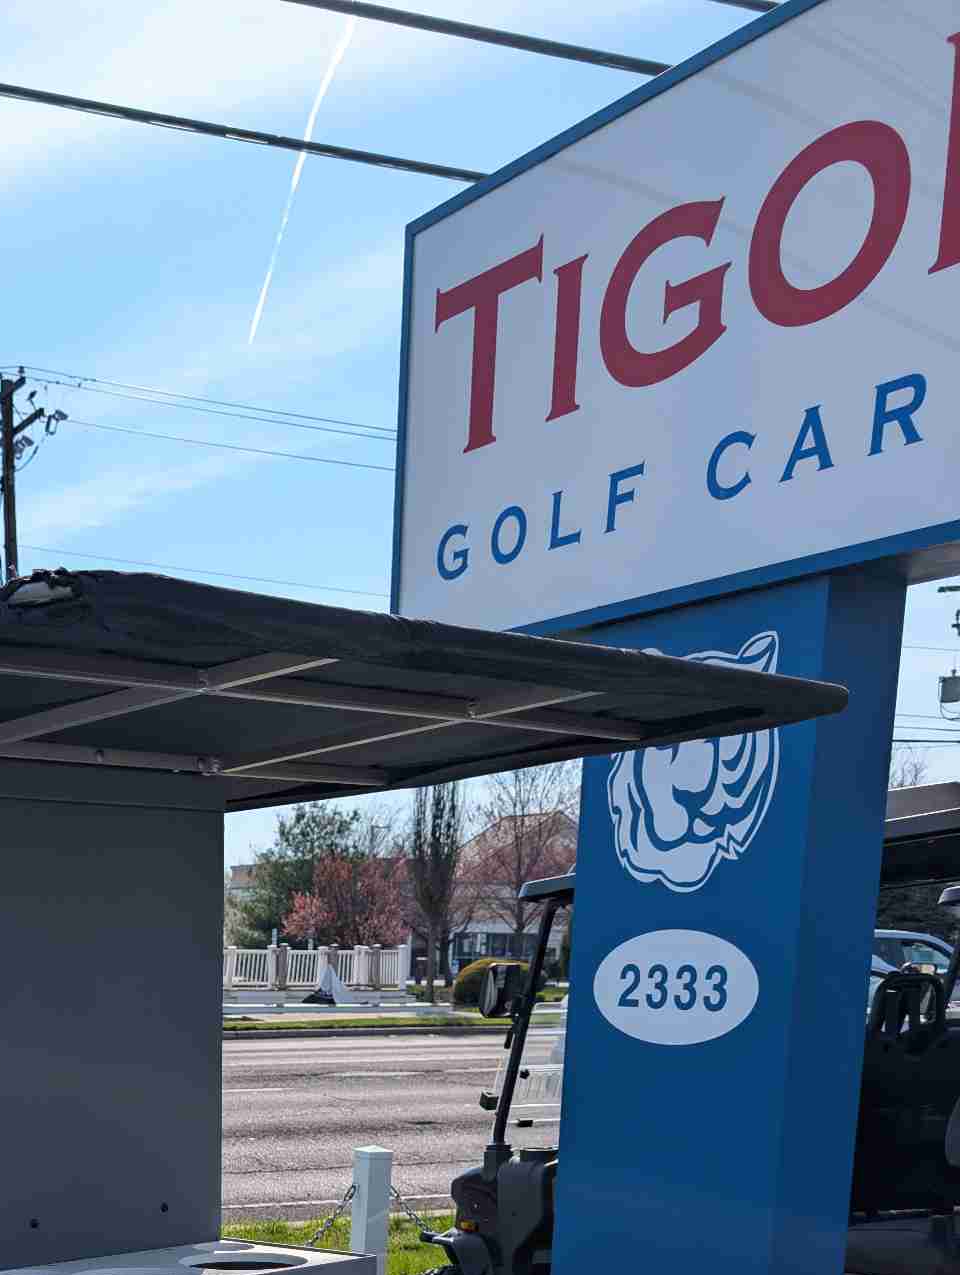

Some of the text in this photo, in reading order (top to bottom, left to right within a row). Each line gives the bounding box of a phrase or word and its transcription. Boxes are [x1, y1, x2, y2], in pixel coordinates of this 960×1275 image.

[435, 31, 960, 454] TIGO
[436, 372, 928, 581] GOLF CAR
[617, 963, 729, 1012] 2333
